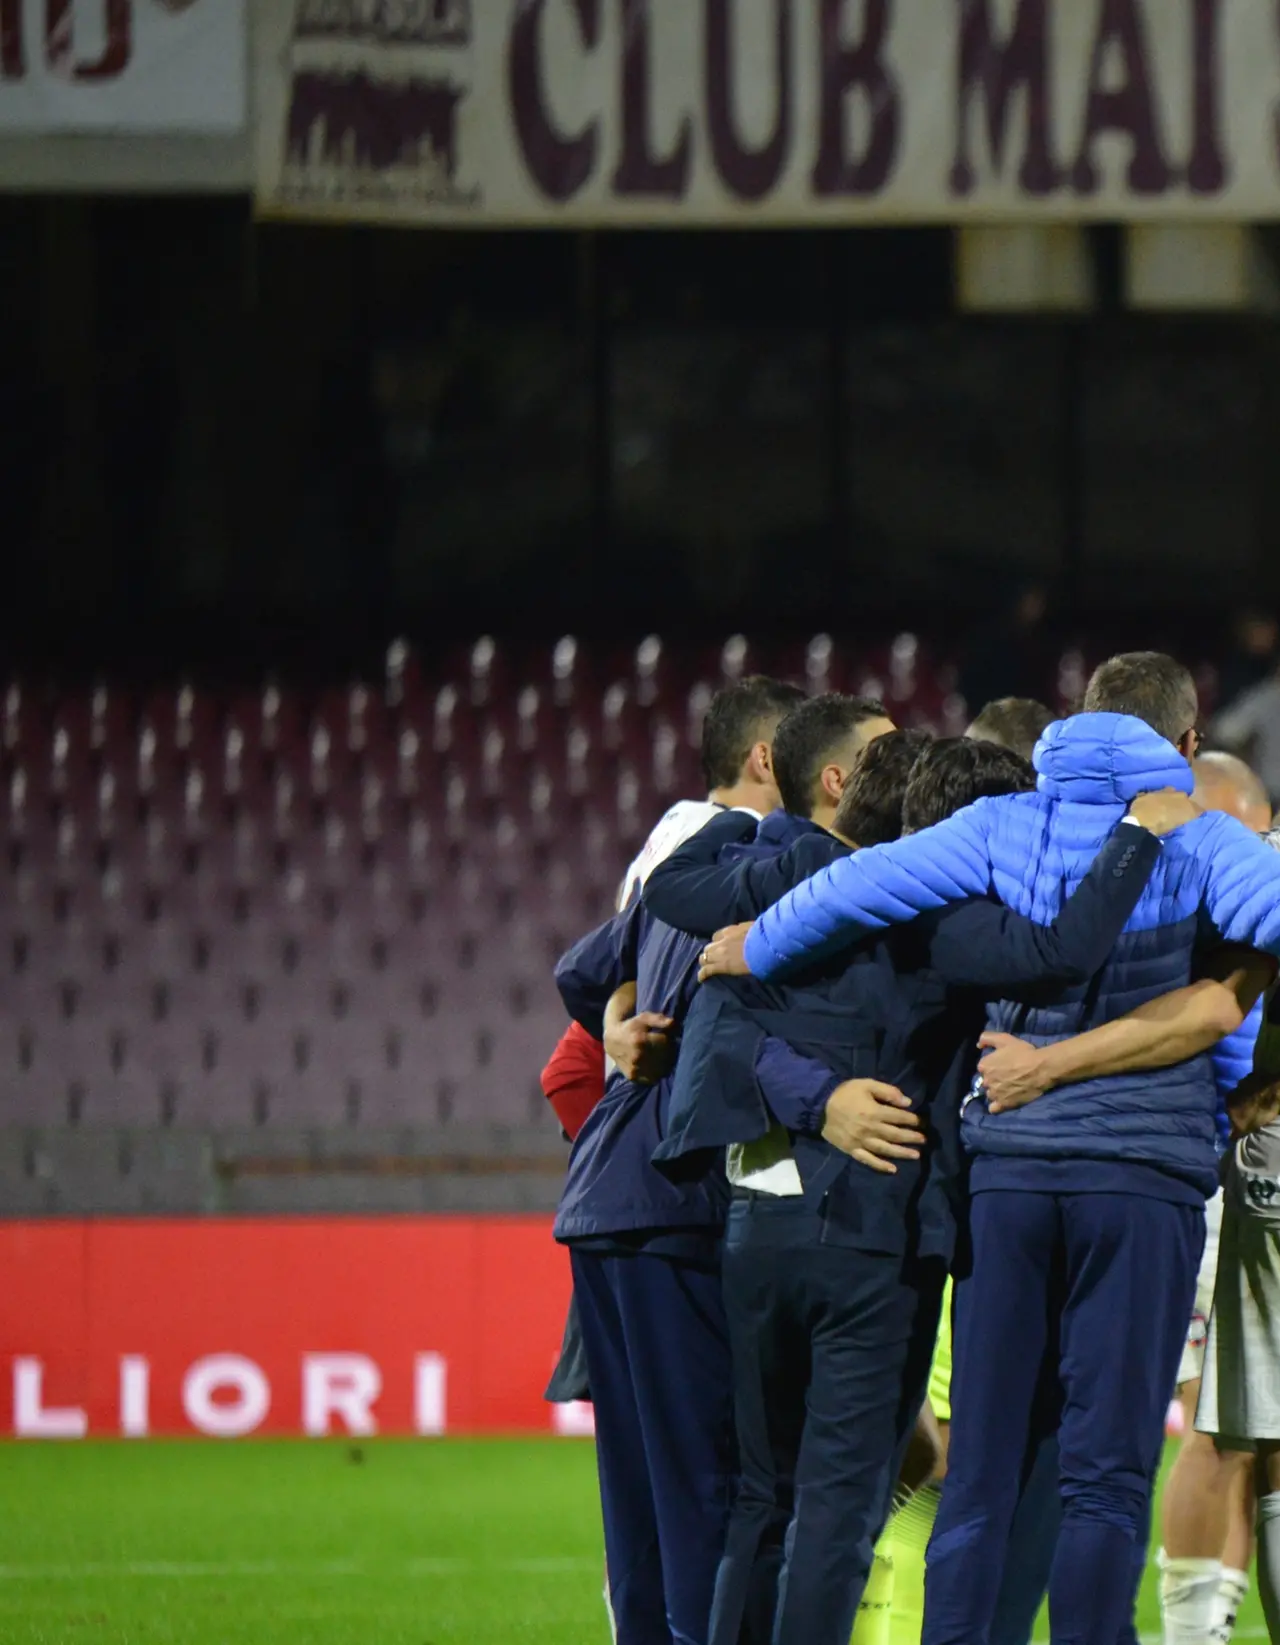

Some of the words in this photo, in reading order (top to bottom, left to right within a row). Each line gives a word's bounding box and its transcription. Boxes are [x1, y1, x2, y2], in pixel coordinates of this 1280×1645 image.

[508, 0, 903, 203] CLUB
[948, 0, 1226, 197] MAI
[12, 1349, 447, 1438] LIORI
